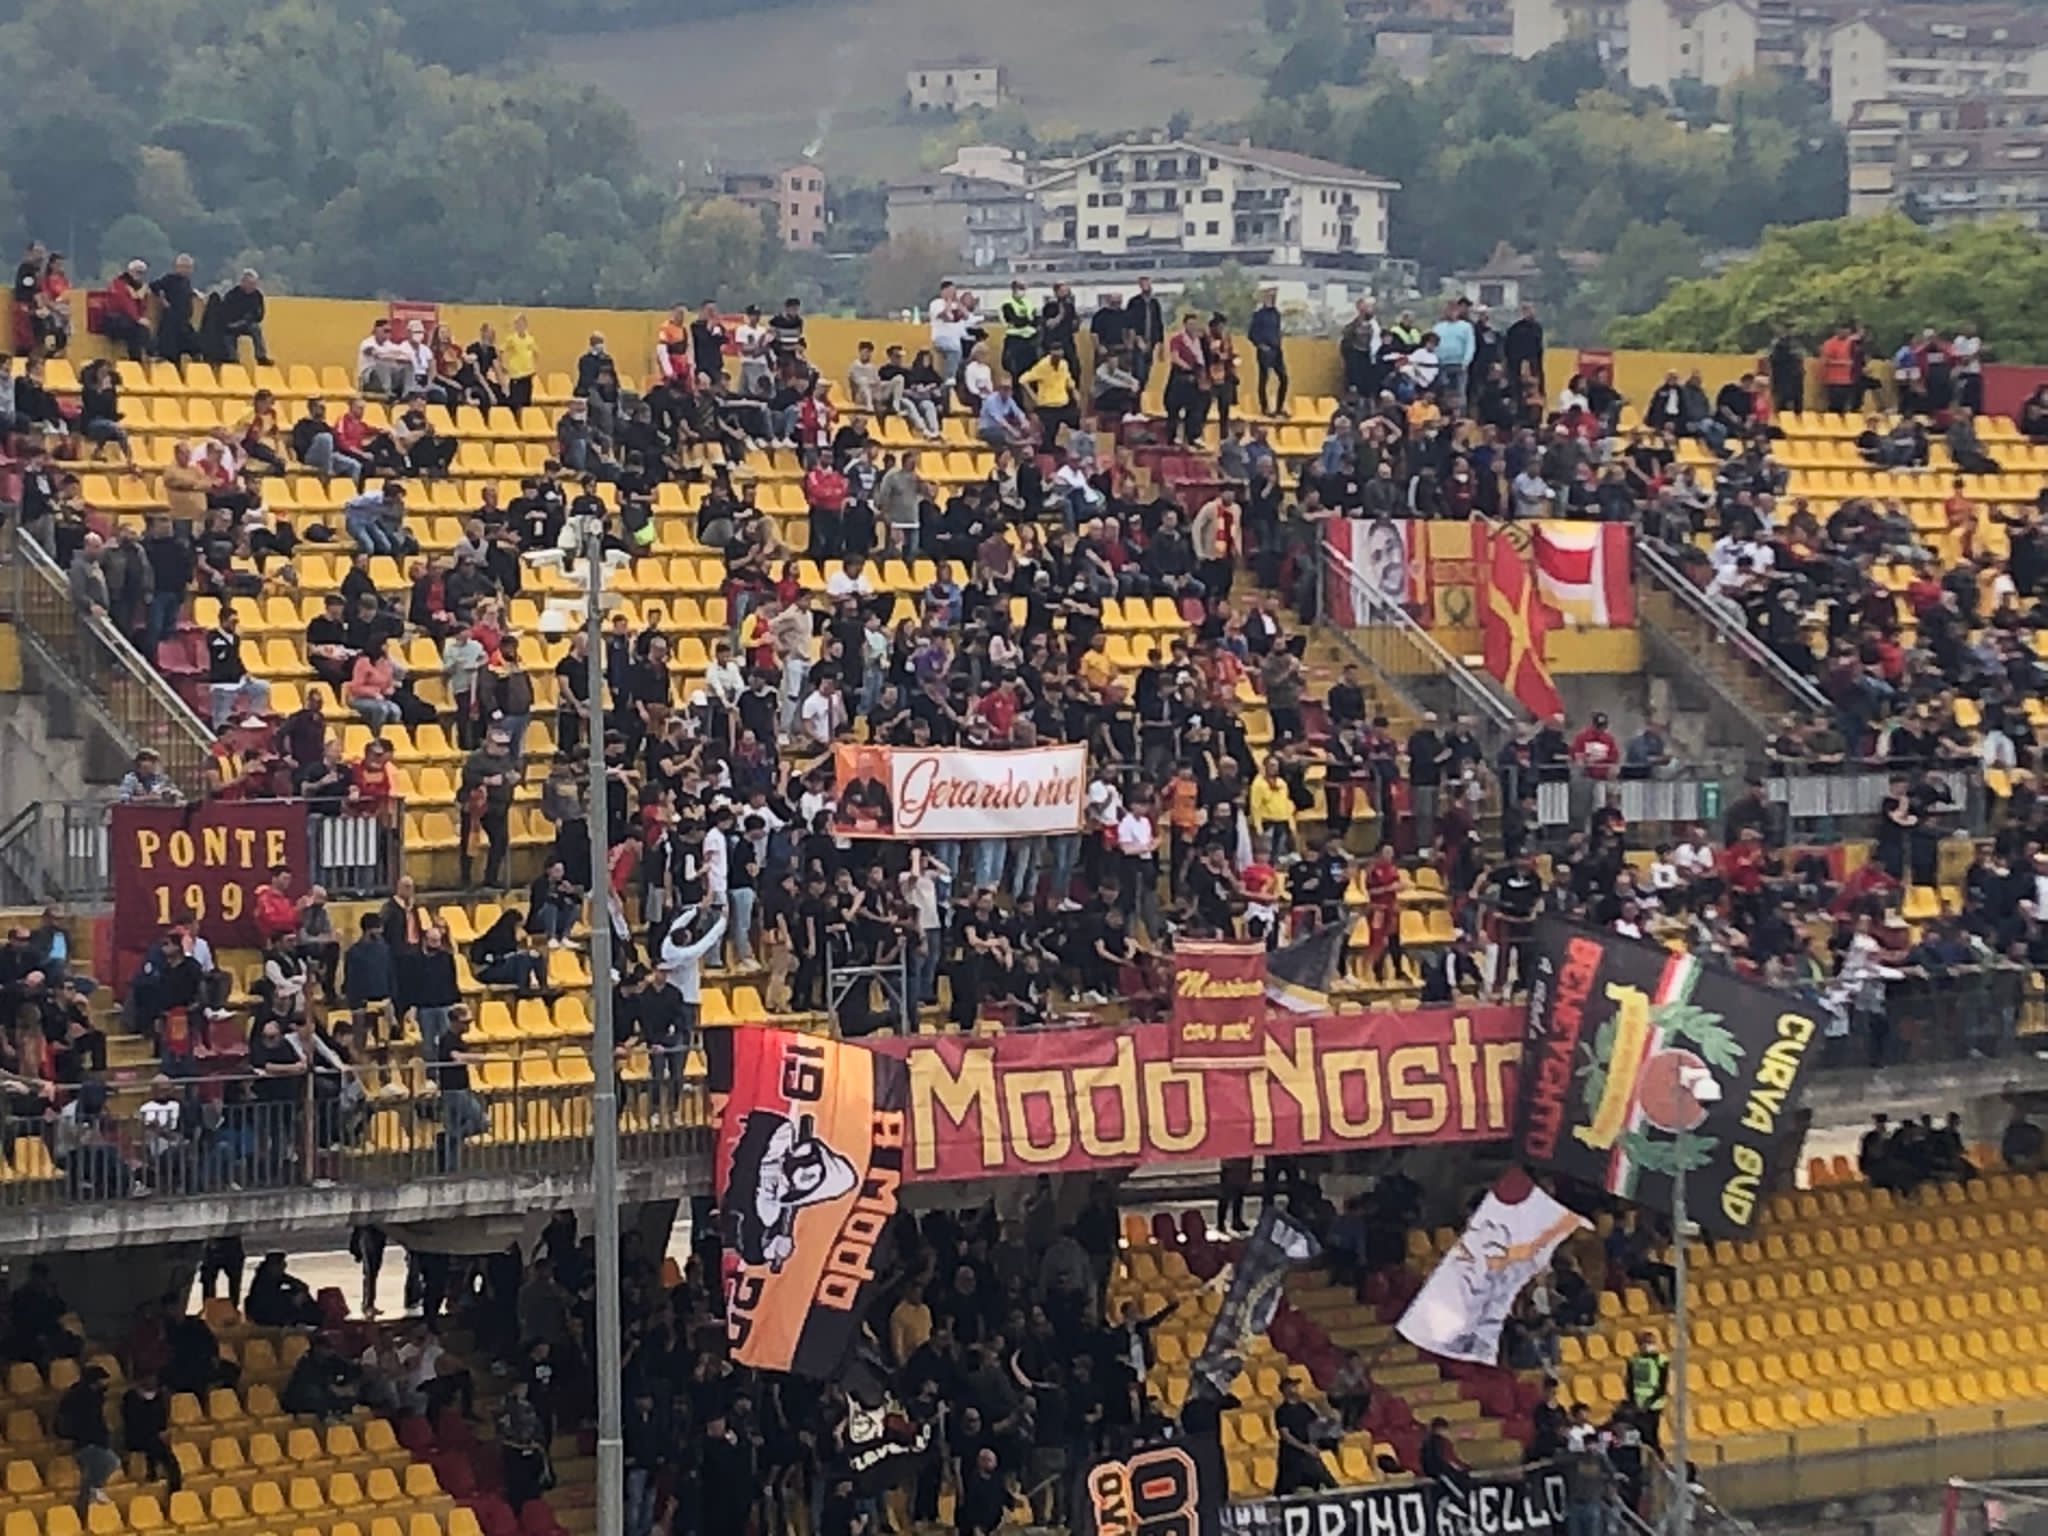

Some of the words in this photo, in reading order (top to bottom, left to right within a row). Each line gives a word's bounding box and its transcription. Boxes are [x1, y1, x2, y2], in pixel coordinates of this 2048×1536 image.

[898, 757, 1028, 829] Gerardo
[136, 826, 288, 869] PONTE
[155, 882, 243, 925] 199
[906, 1034, 1207, 1172] Modo
[1251, 1016, 1524, 1146] Nostr
[1526, 937, 1605, 1160] BENEVENTO
[1740, 1013, 1816, 1135] CURVA
[1721, 1144, 1765, 1227] SUD
[815, 1166, 901, 1311] Modo
